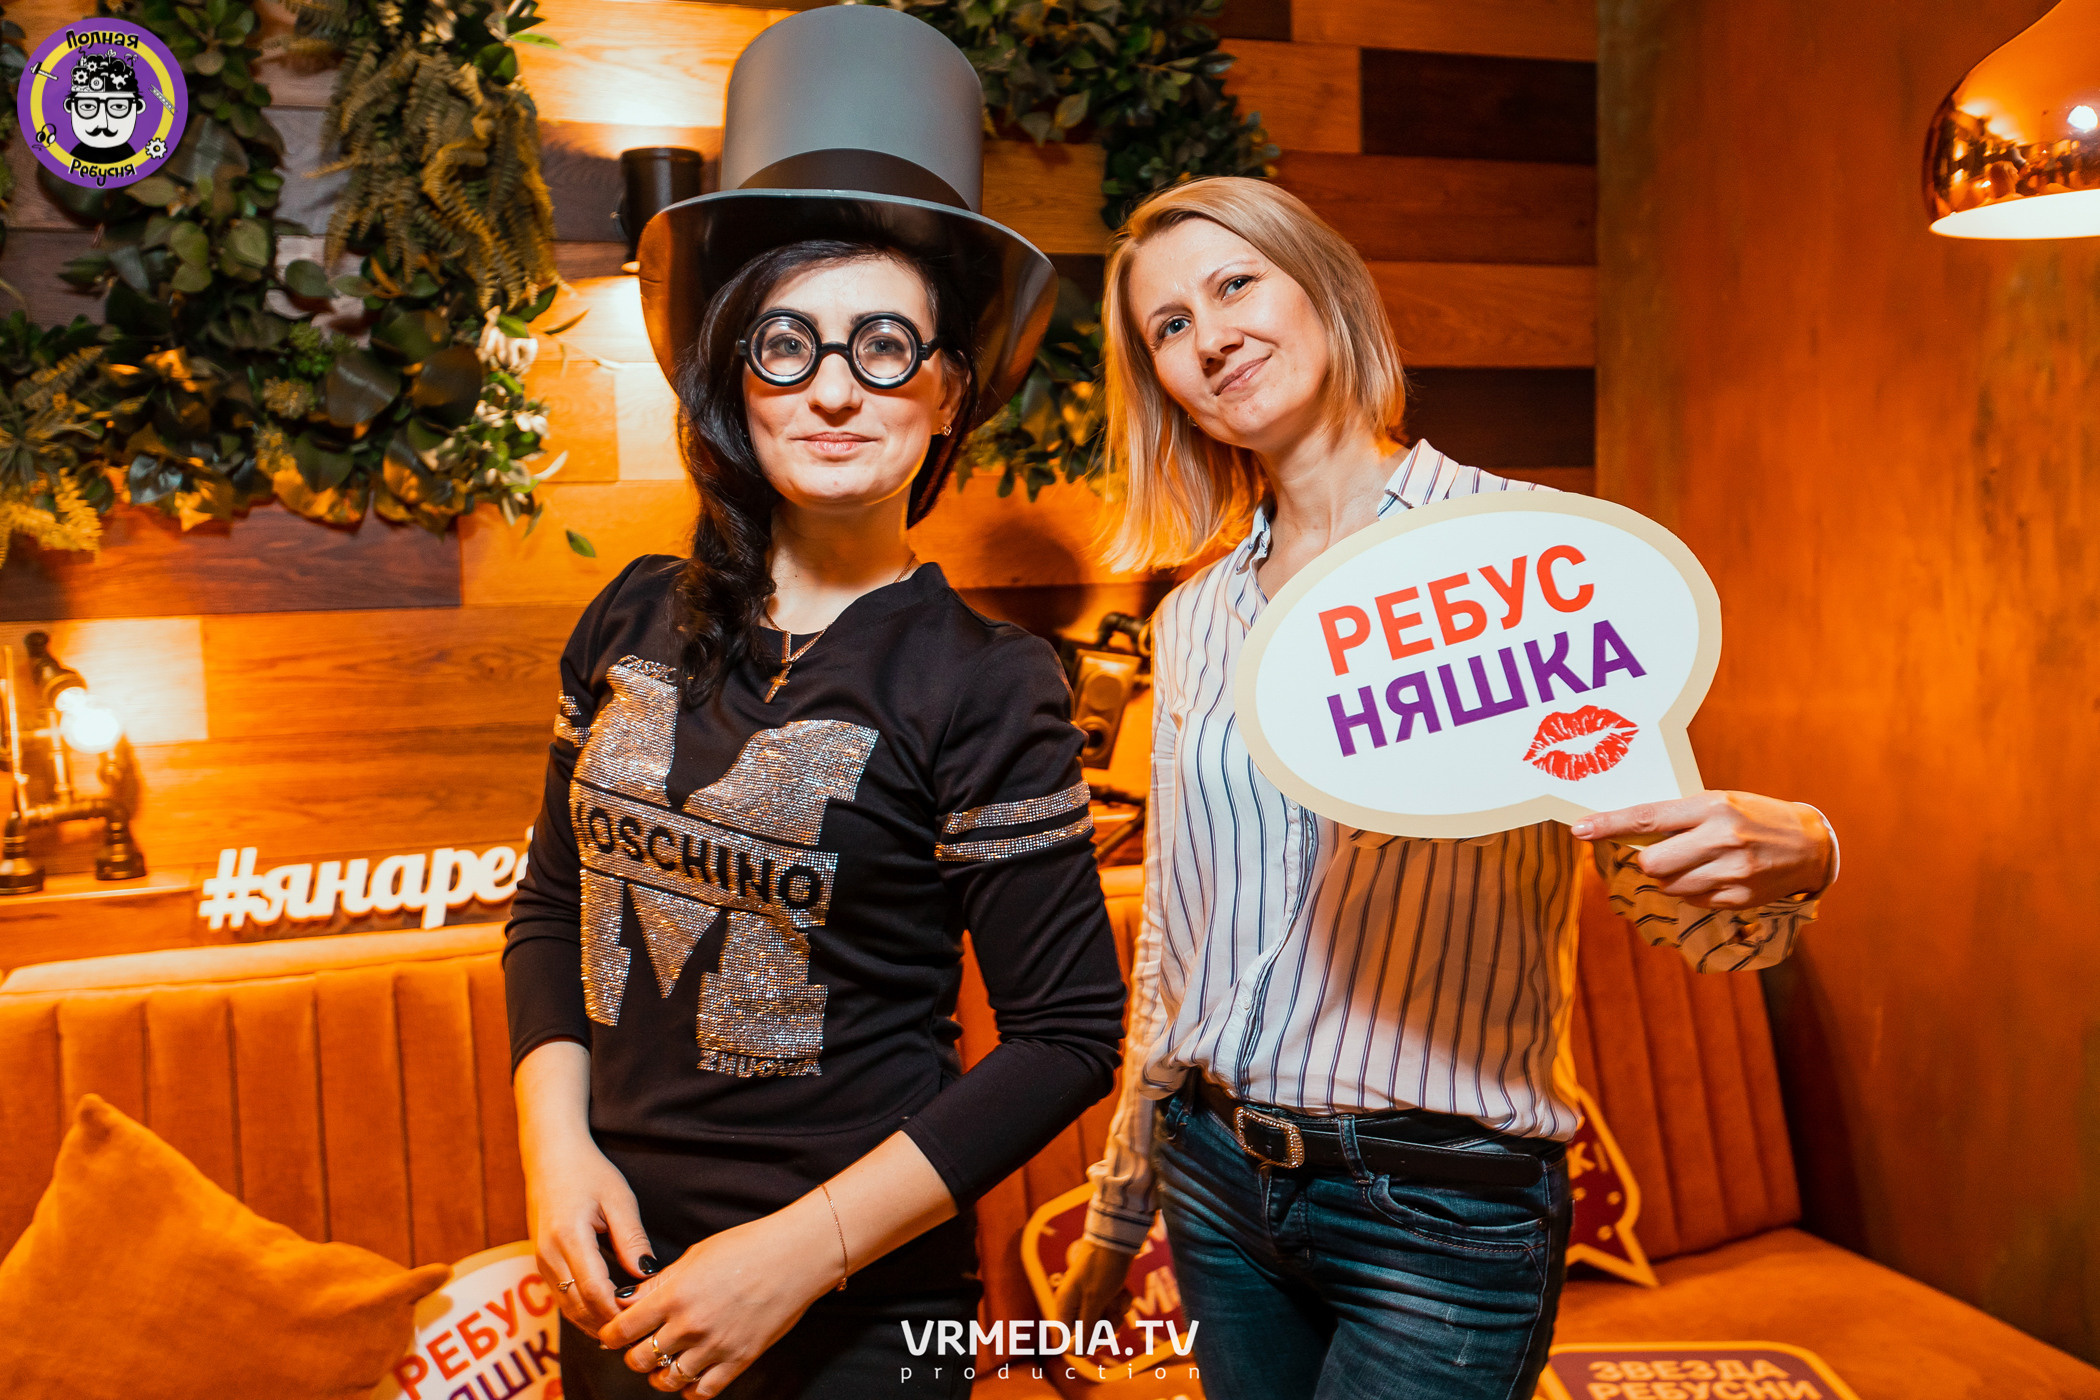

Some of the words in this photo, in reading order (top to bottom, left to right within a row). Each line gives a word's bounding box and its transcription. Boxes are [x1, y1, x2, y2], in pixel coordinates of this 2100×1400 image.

[1318, 544, 1595, 676] РЕБУС
[1326, 619, 1647, 757] НЯШКА
[198, 826, 534, 930] #янаре
[393, 1273, 555, 1400] РЕБУС
[1586, 1380, 1823, 1400] РЕБУСНИ
[1587, 1358, 1790, 1382] ЗВЕЗДА
